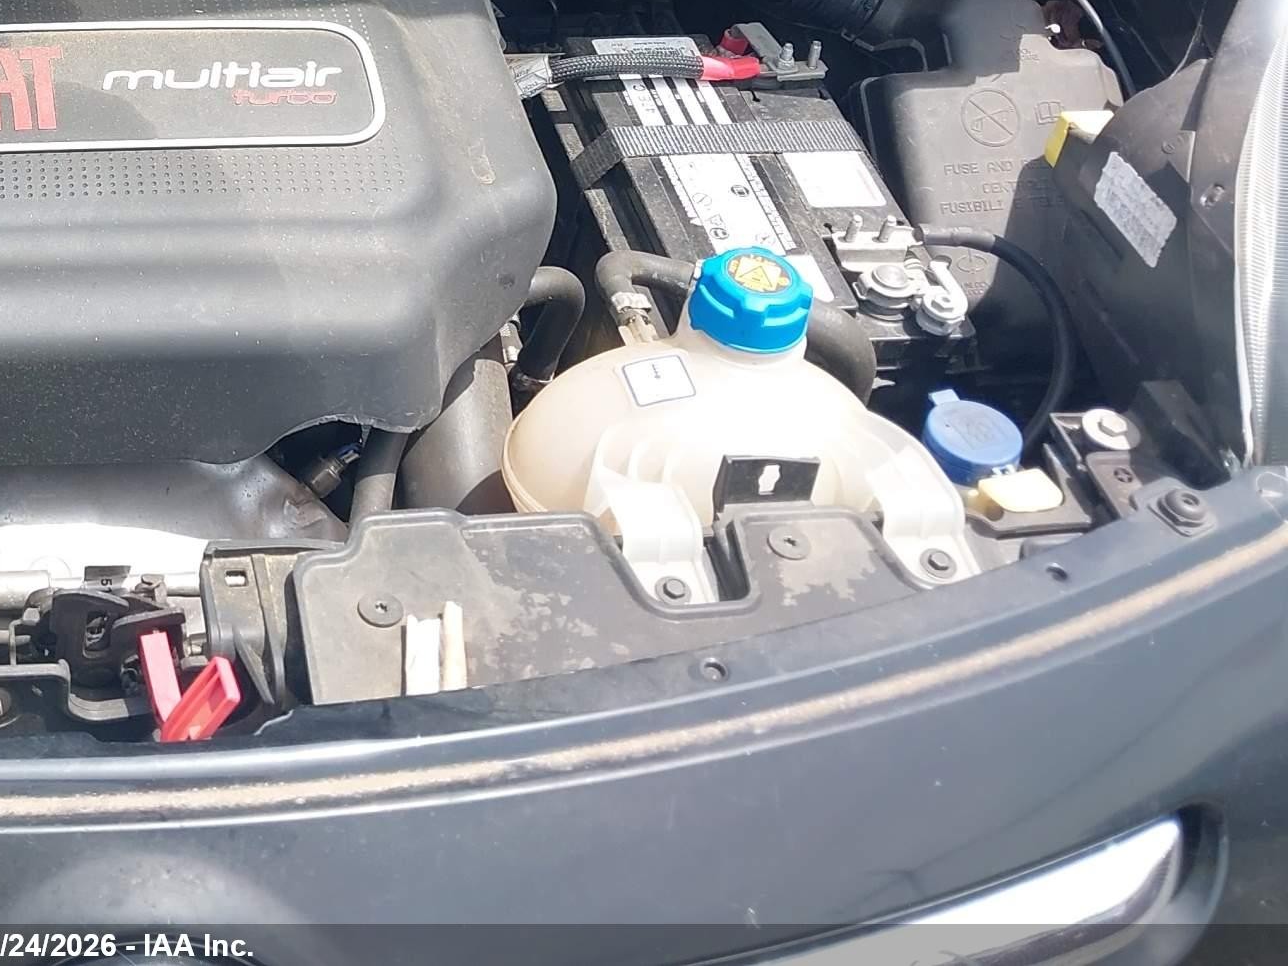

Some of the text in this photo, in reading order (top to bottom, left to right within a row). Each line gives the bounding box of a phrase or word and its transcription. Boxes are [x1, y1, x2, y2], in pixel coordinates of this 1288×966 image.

[101, 61, 343, 90] multiair
[232, 89, 337, 106] turbo
[943, 162, 980, 175] FUSE
[987, 159, 1014, 173] AND
